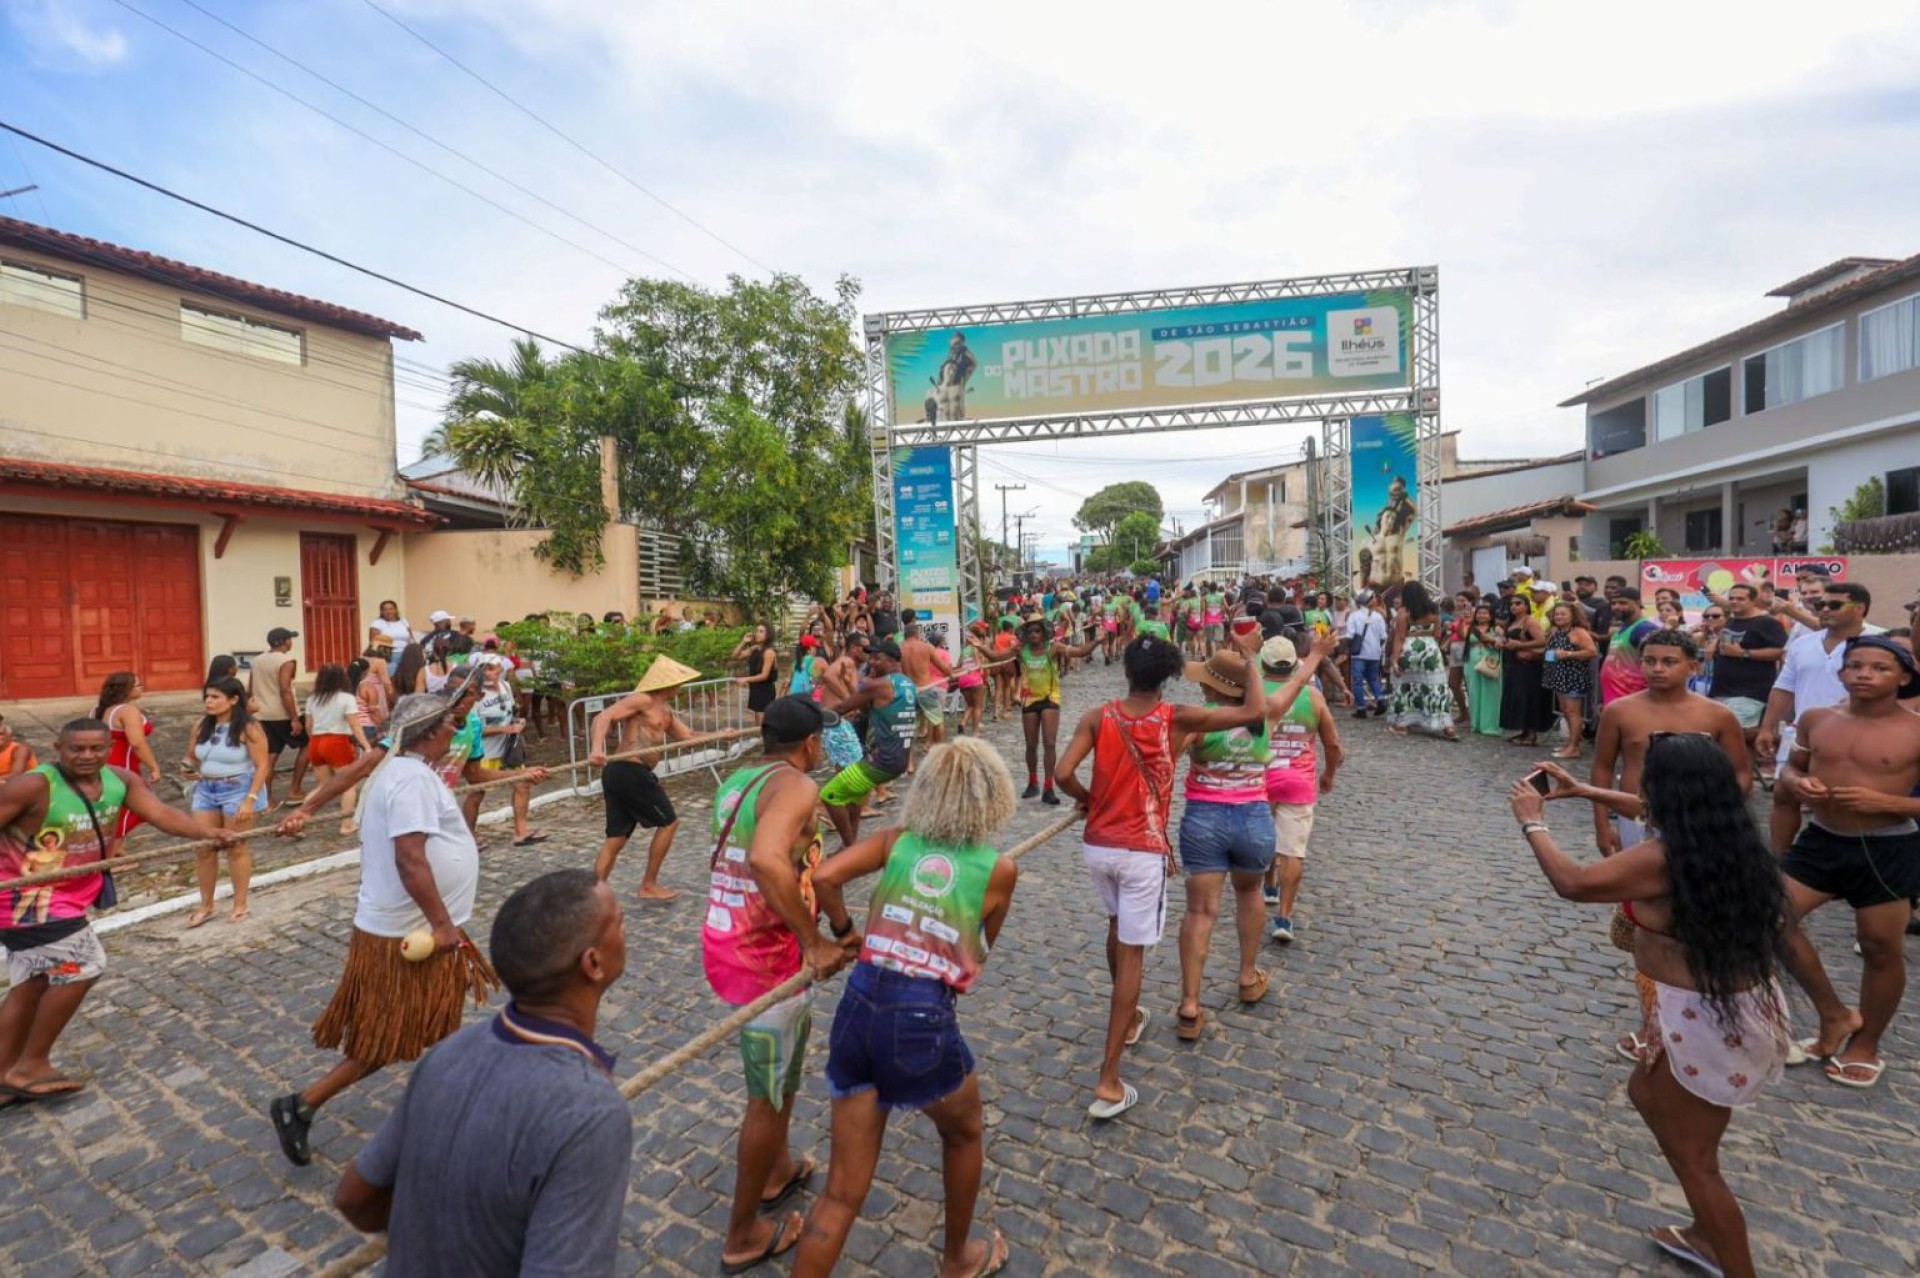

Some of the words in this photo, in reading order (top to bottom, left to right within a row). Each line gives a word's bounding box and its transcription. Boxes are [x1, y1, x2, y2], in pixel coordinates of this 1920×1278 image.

[1161, 328, 1177, 338] DE
[1224, 317, 1309, 332] SEBASTIÃO
[1002, 329, 1140, 371] PUXADA
[1154, 330, 1314, 387] 2026
[1003, 361, 1143, 399] MASTRO
